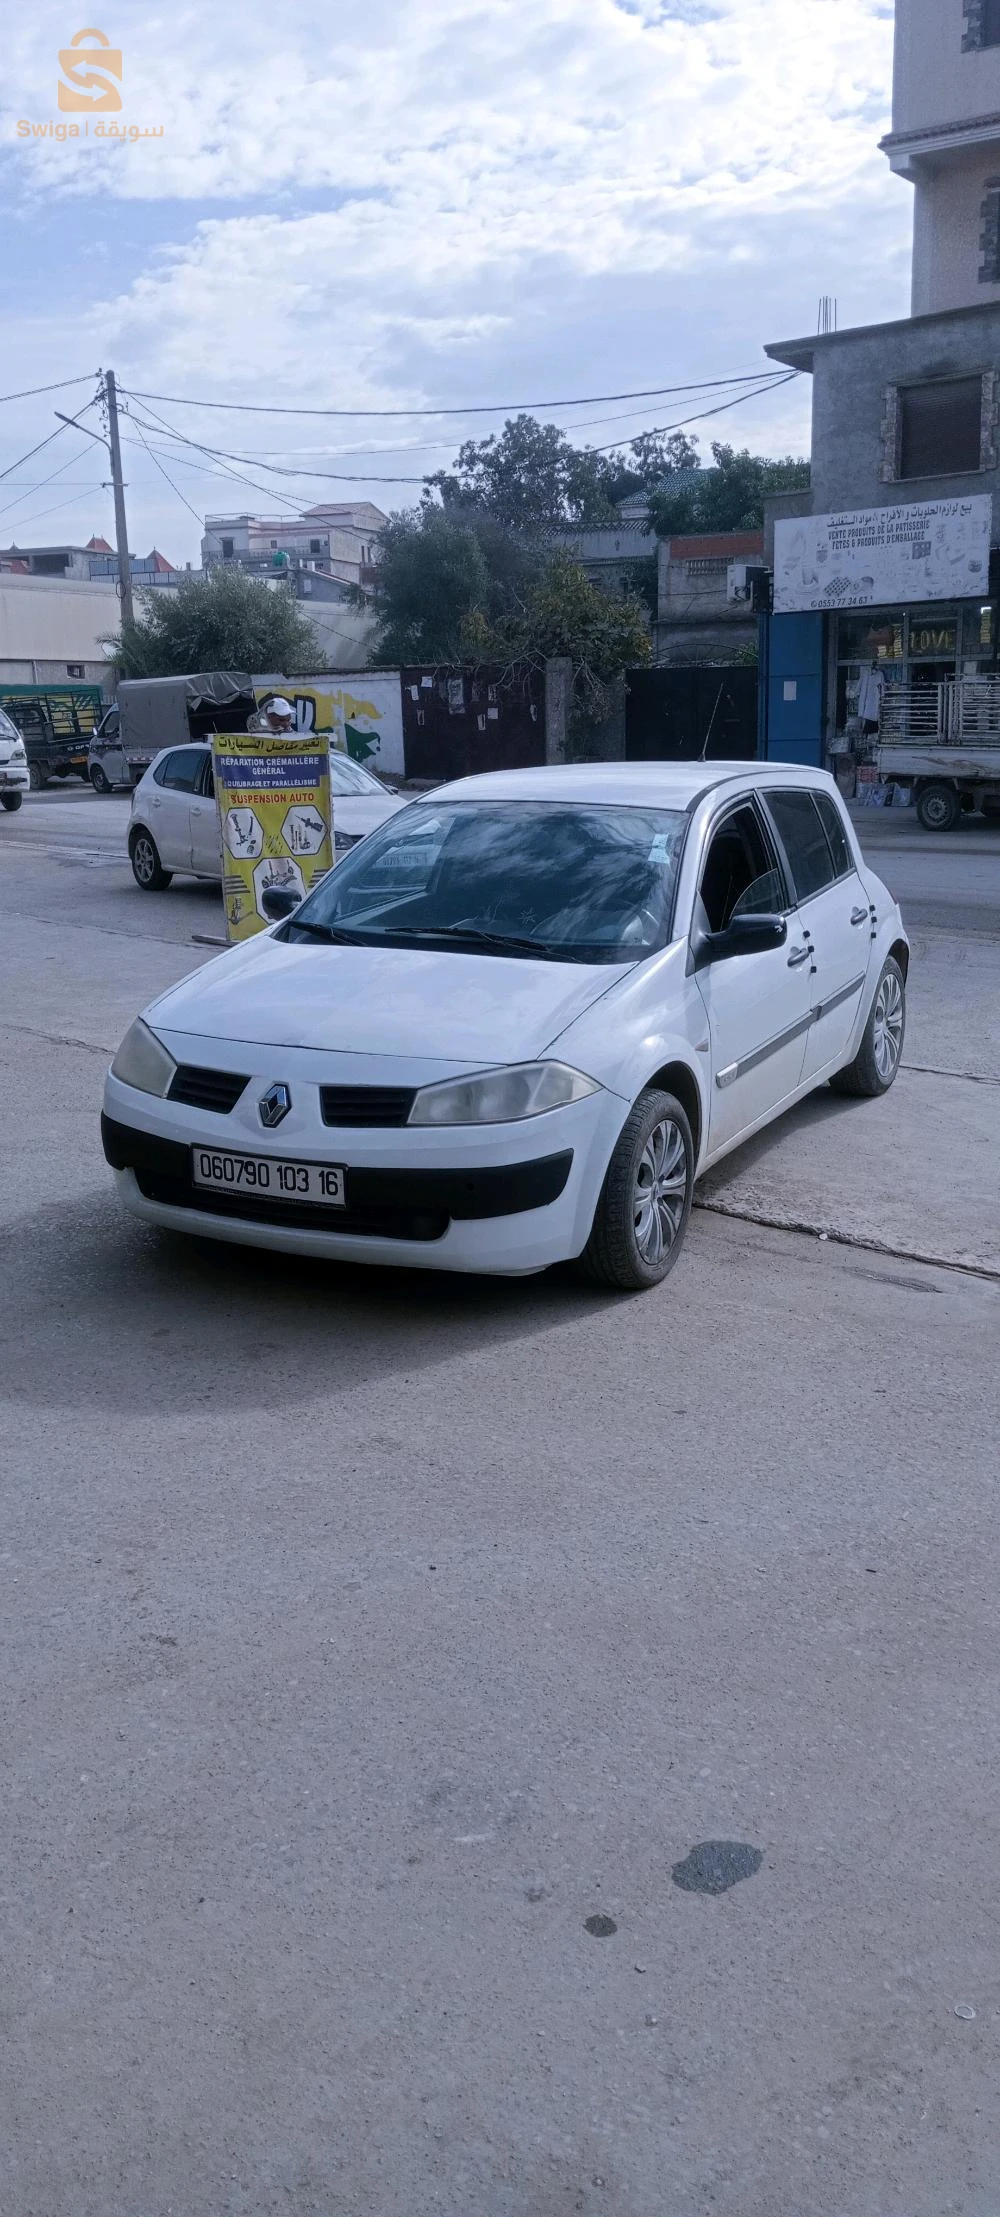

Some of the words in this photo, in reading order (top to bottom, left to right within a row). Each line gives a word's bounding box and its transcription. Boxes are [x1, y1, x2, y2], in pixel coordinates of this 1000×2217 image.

[828, 529, 847, 541] VENTE
[847, 525, 875, 538] PRODUITS
[877, 524, 885, 535] DE
[886, 523, 894, 534] LA
[857, 535, 885, 547] PRODUITS
[818, 599, 836, 608] 0553
[220, 755, 265, 767] RÉPARATION
[252, 765, 286, 775] GÉNÉRAL
[263, 780, 271, 788] ET
[230, 793, 287, 804] SUSPENSION
[289, 792, 315, 802] AUTO
[200, 1153, 270, 1188] 060790
[277, 1165, 310, 1193] 103
[318, 1171, 339, 1196] 16
